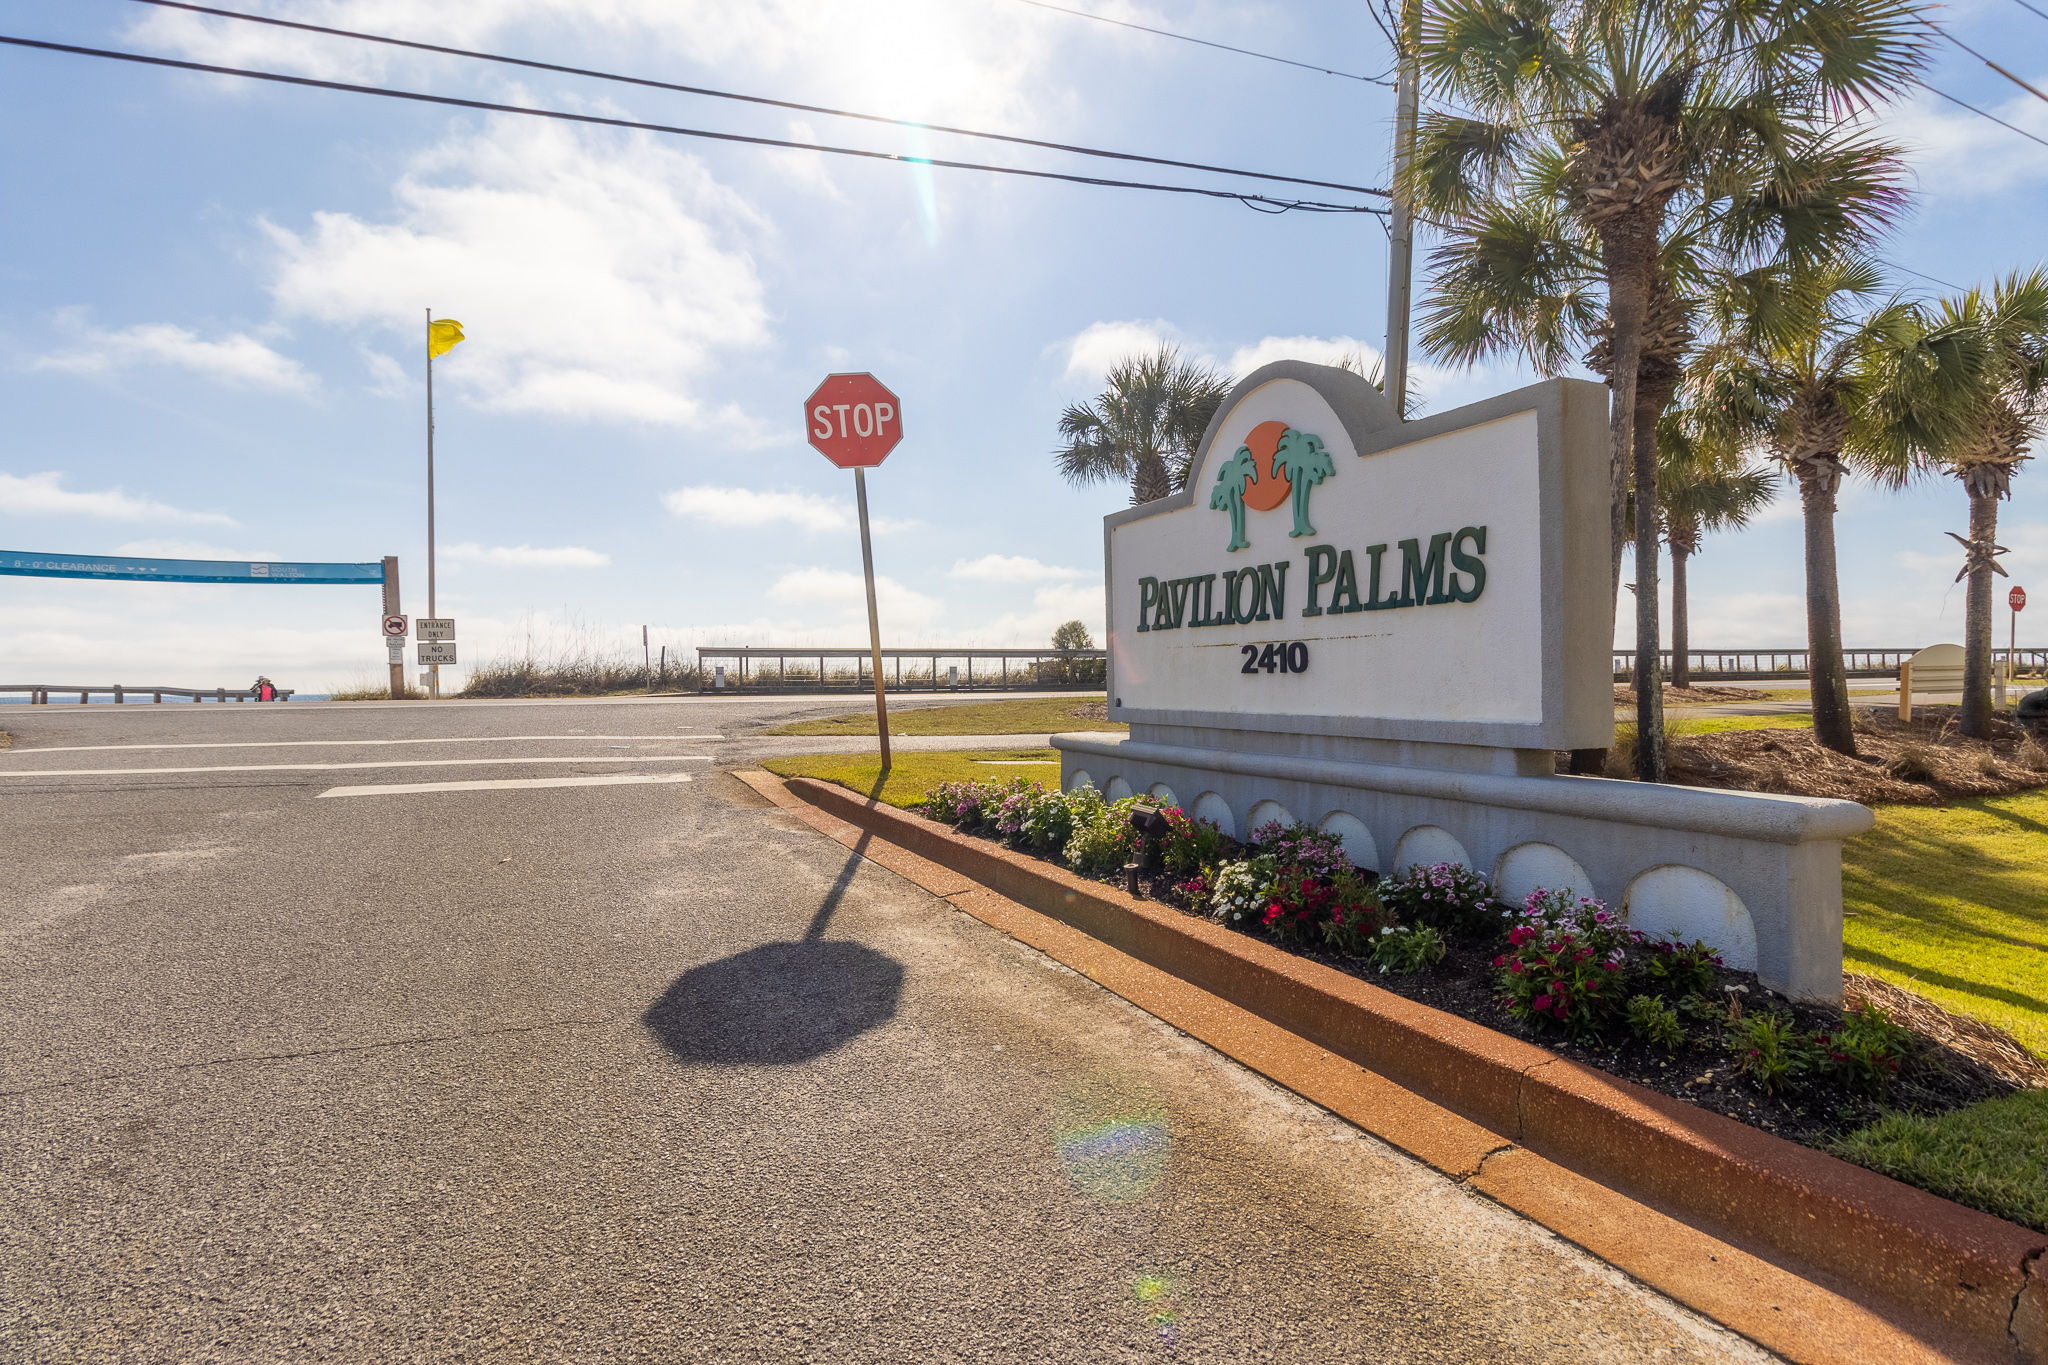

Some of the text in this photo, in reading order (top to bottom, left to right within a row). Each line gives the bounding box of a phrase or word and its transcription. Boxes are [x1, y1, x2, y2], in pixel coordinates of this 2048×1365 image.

[813, 402, 894, 440] STOP
[46, 561, 117, 572] CLEARANCE
[1136, 525, 1488, 633] PAVILION PALMS
[2009, 593, 2025, 604] STOP
[420, 621, 452, 629] ENTRANCE
[1240, 641, 1310, 675] 2410
